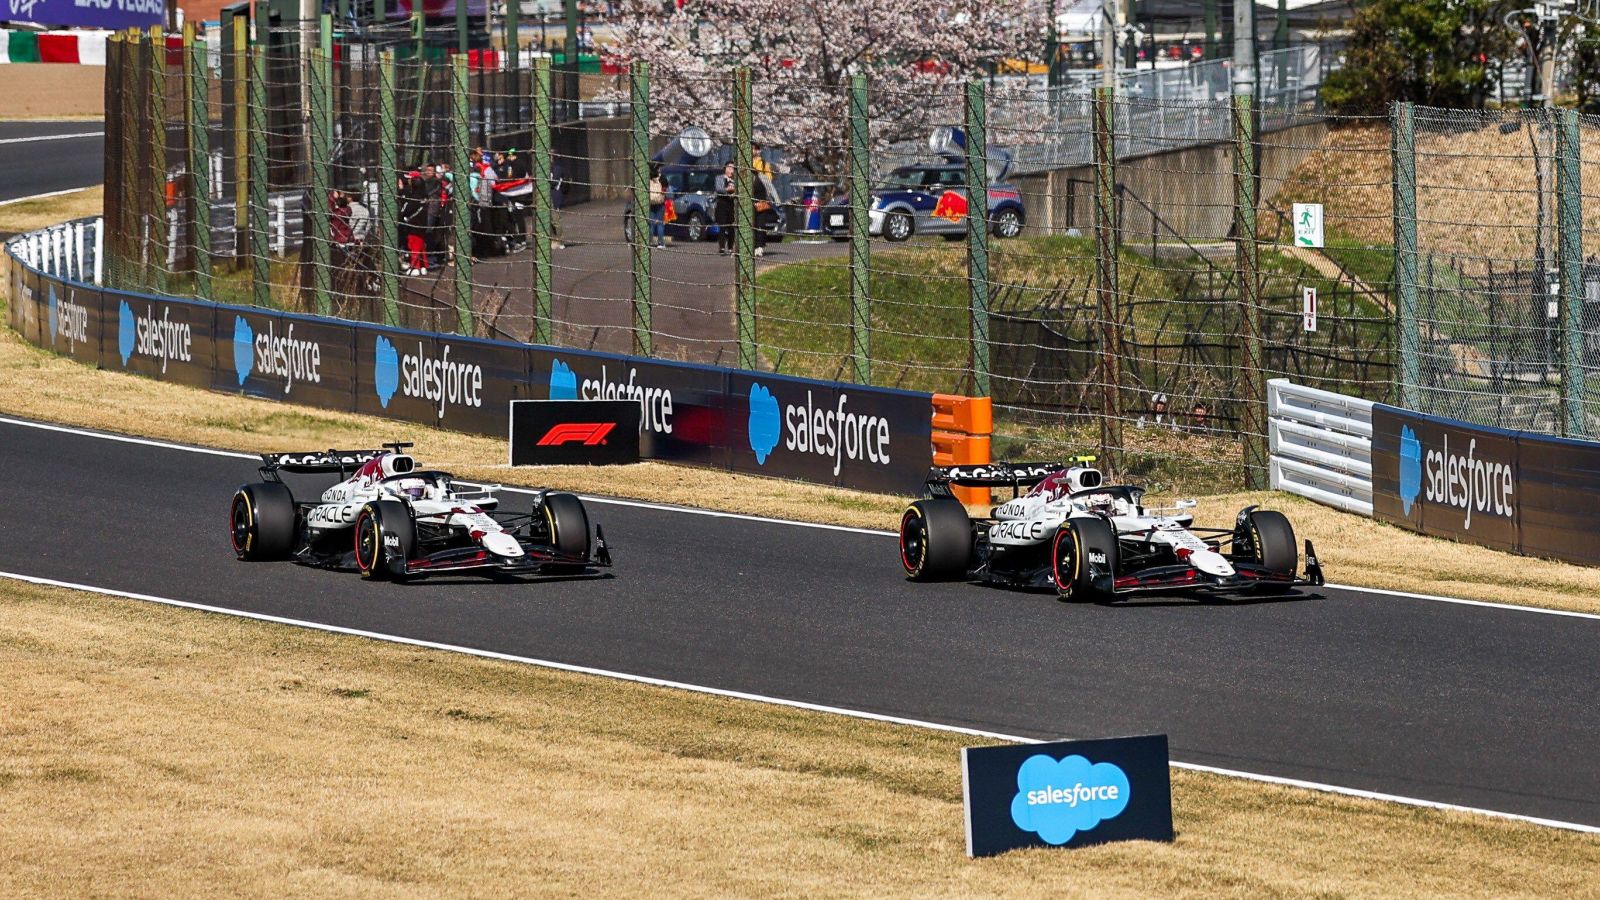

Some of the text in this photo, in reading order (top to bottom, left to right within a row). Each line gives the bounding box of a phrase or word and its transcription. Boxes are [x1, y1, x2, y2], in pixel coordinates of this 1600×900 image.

[137, 304, 192, 374] salesforce
[256, 320, 321, 394] salesforce
[402, 341, 483, 419] salesforce
[536, 422, 617, 446] F1
[785, 390, 891, 476] salesforce
[1426, 433, 1513, 530] salesforce
[308, 505, 357, 523] ORACLE
[997, 503, 1025, 517] HONDA
[383, 535, 399, 547] Mobil
[991, 521, 1047, 540] ORACLE
[1088, 552, 1106, 564] Mobil
[1027, 782, 1119, 808] salesforce
